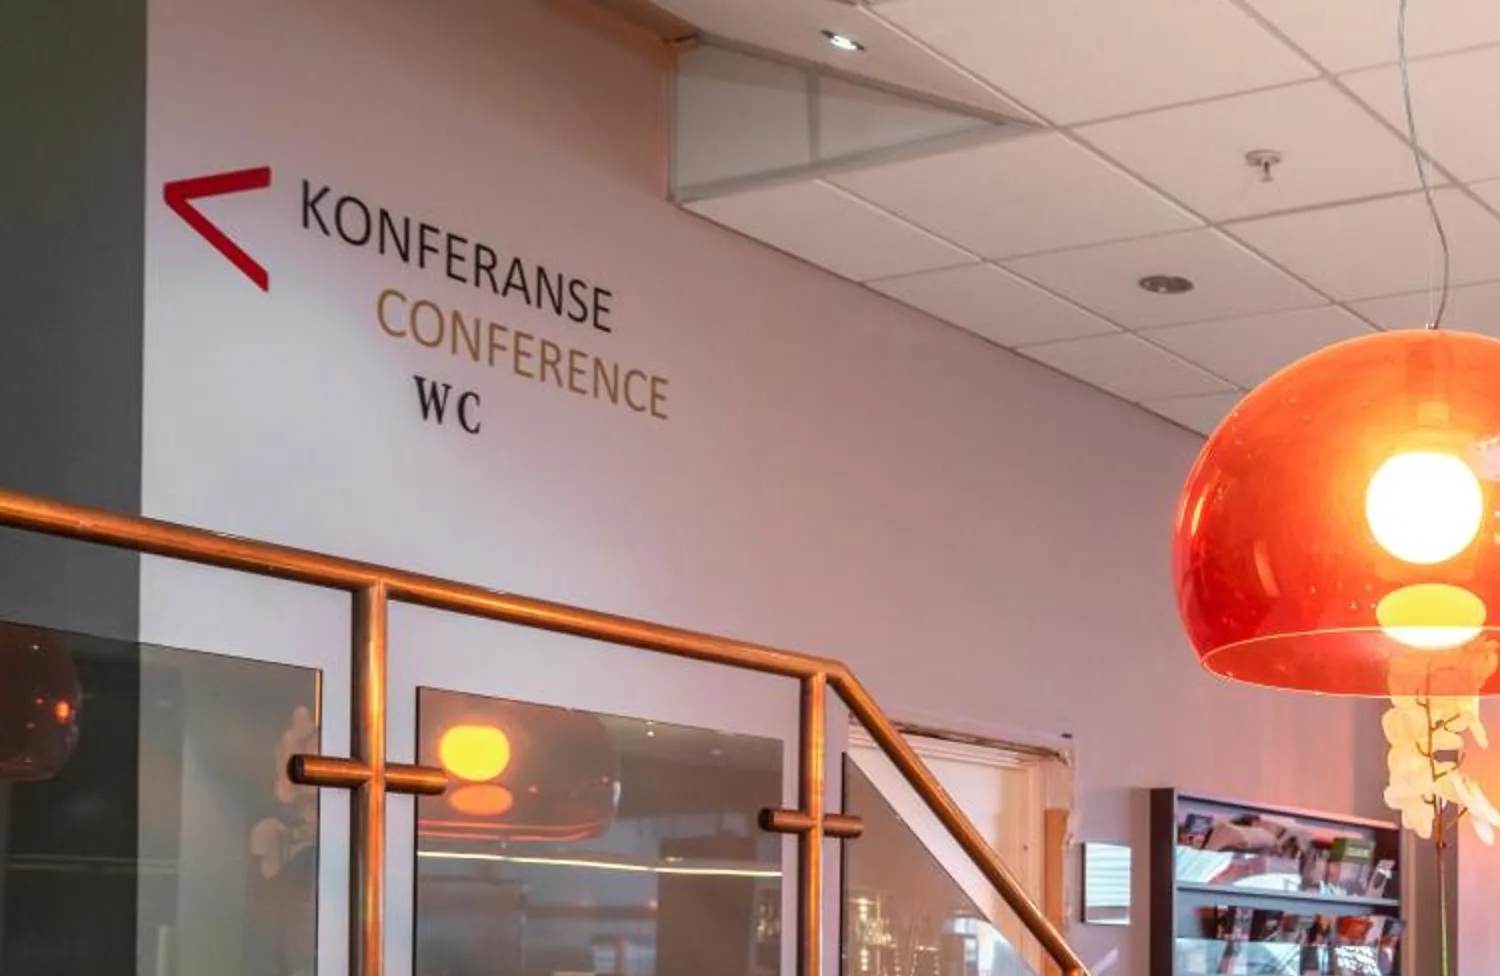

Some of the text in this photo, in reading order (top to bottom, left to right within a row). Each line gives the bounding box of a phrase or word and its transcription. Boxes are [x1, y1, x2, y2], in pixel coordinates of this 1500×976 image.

[301, 179, 613, 334] KONFERANSE
[376, 288, 671, 421] CONFERENCE
[412, 374, 482, 435] WC
